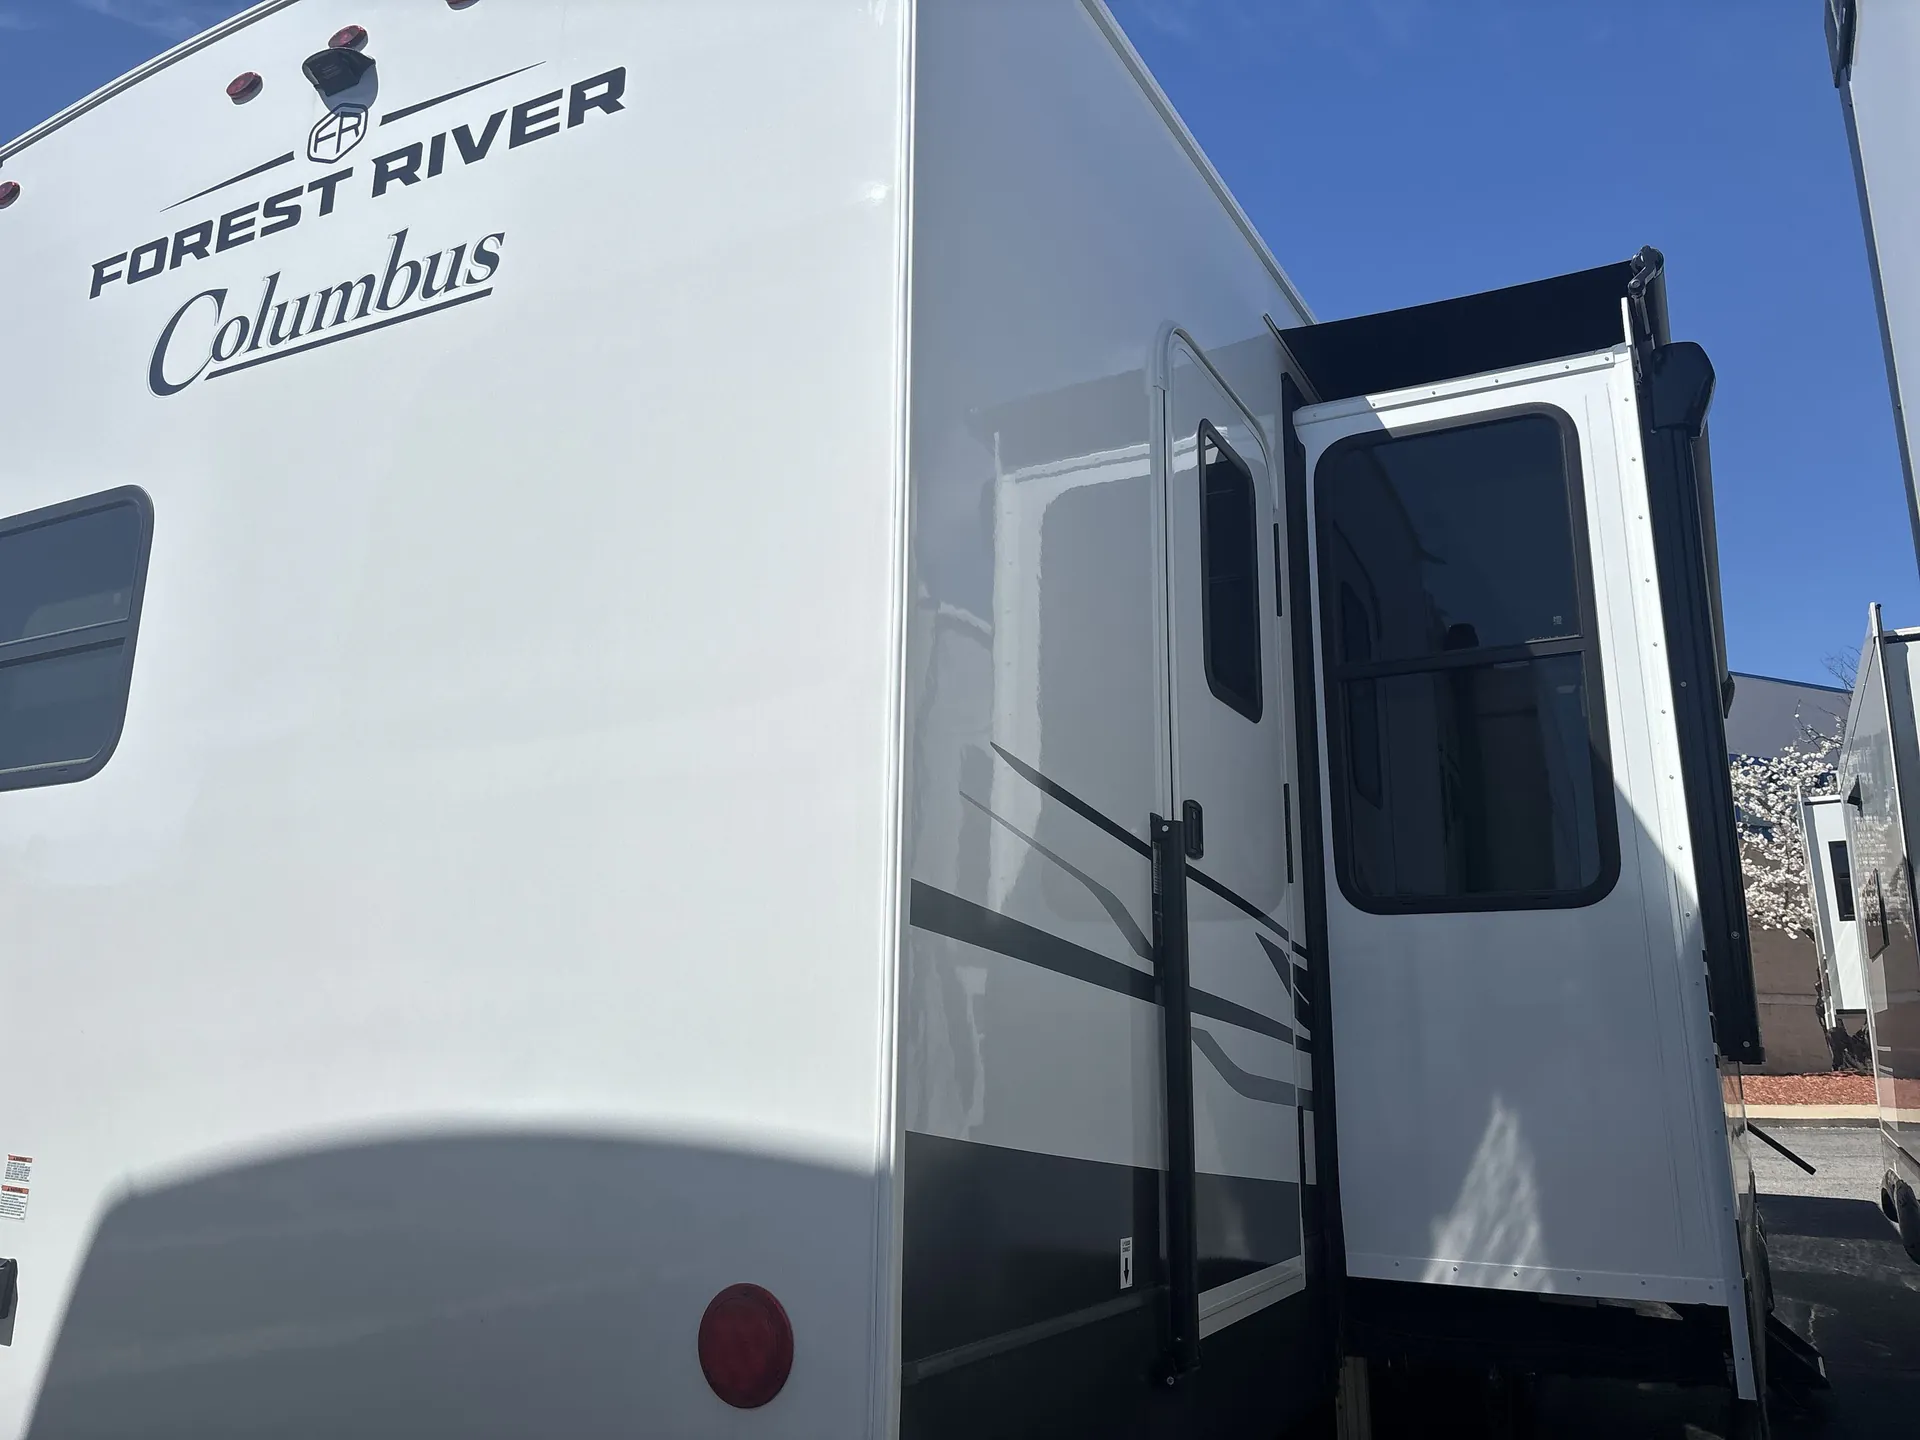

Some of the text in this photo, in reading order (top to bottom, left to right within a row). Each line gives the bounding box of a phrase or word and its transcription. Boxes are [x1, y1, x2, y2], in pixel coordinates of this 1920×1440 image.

[89, 66, 627, 300] FOREST RIVER
[148, 228, 505, 397] Columbus
